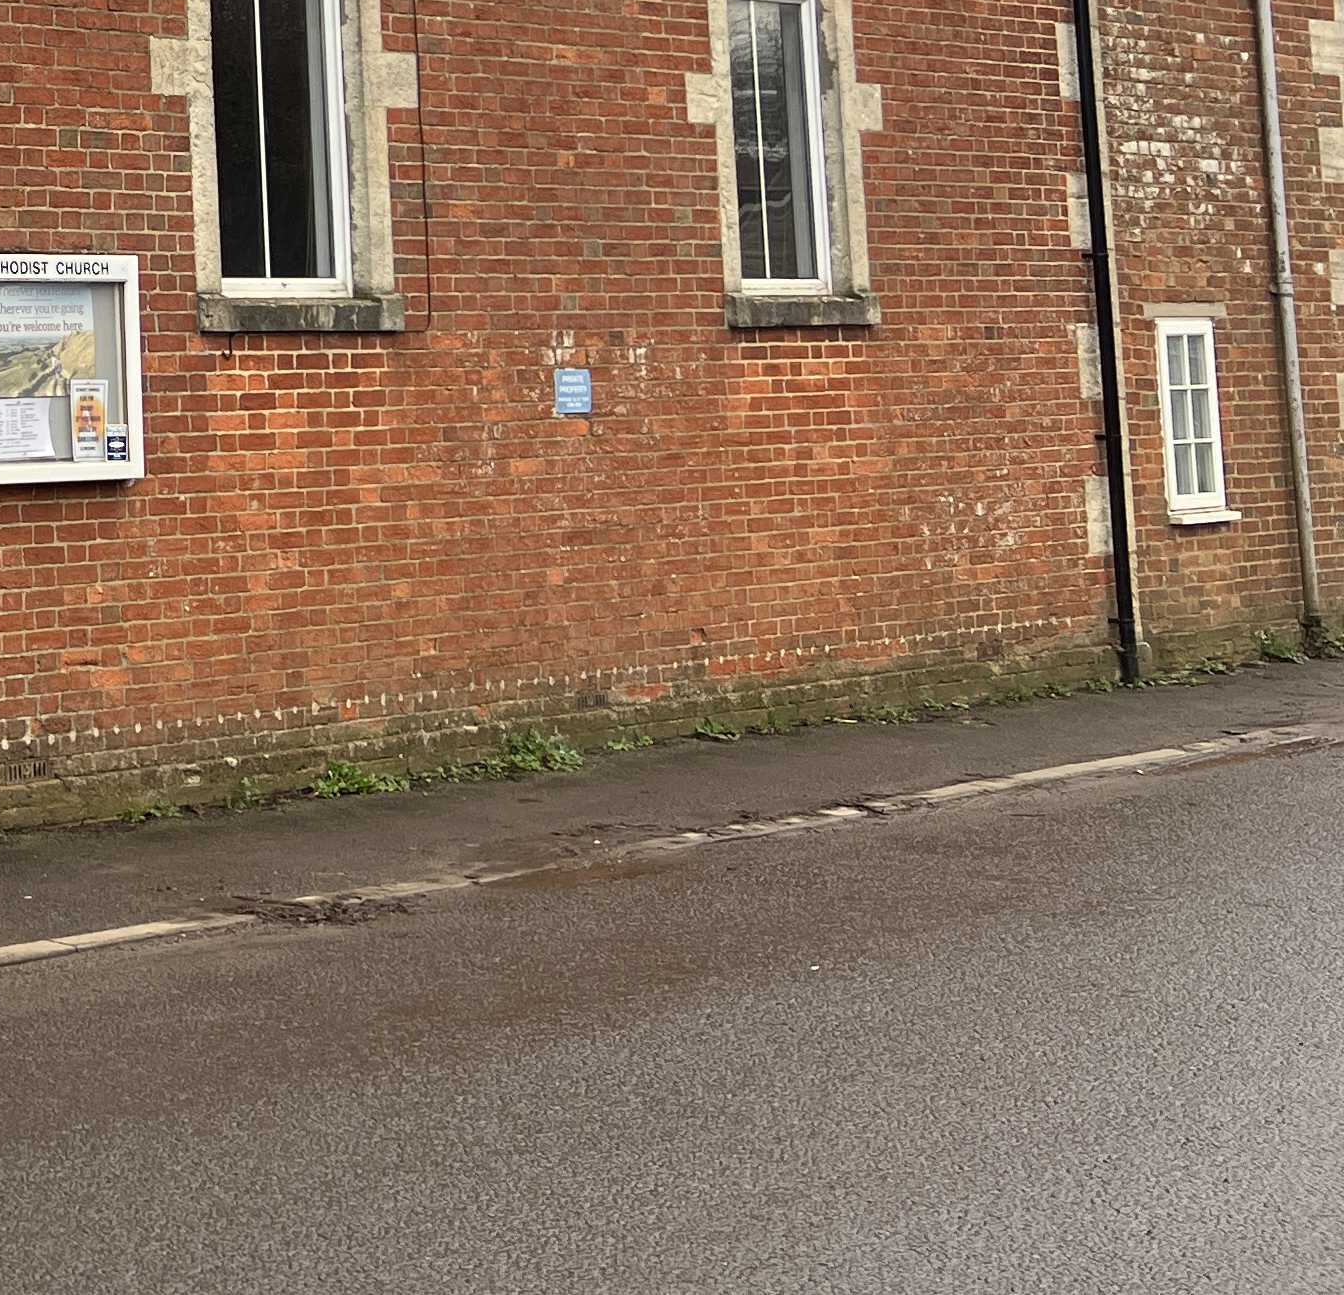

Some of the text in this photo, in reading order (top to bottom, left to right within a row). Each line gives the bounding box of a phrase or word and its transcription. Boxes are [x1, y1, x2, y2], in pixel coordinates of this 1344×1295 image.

[56, 262, 109, 275] CHURCH
[34, 303, 59, 316] you're
[61, 303, 84, 315] going
[23, 320, 62, 332] welcome
[62, 319, 84, 332] here
